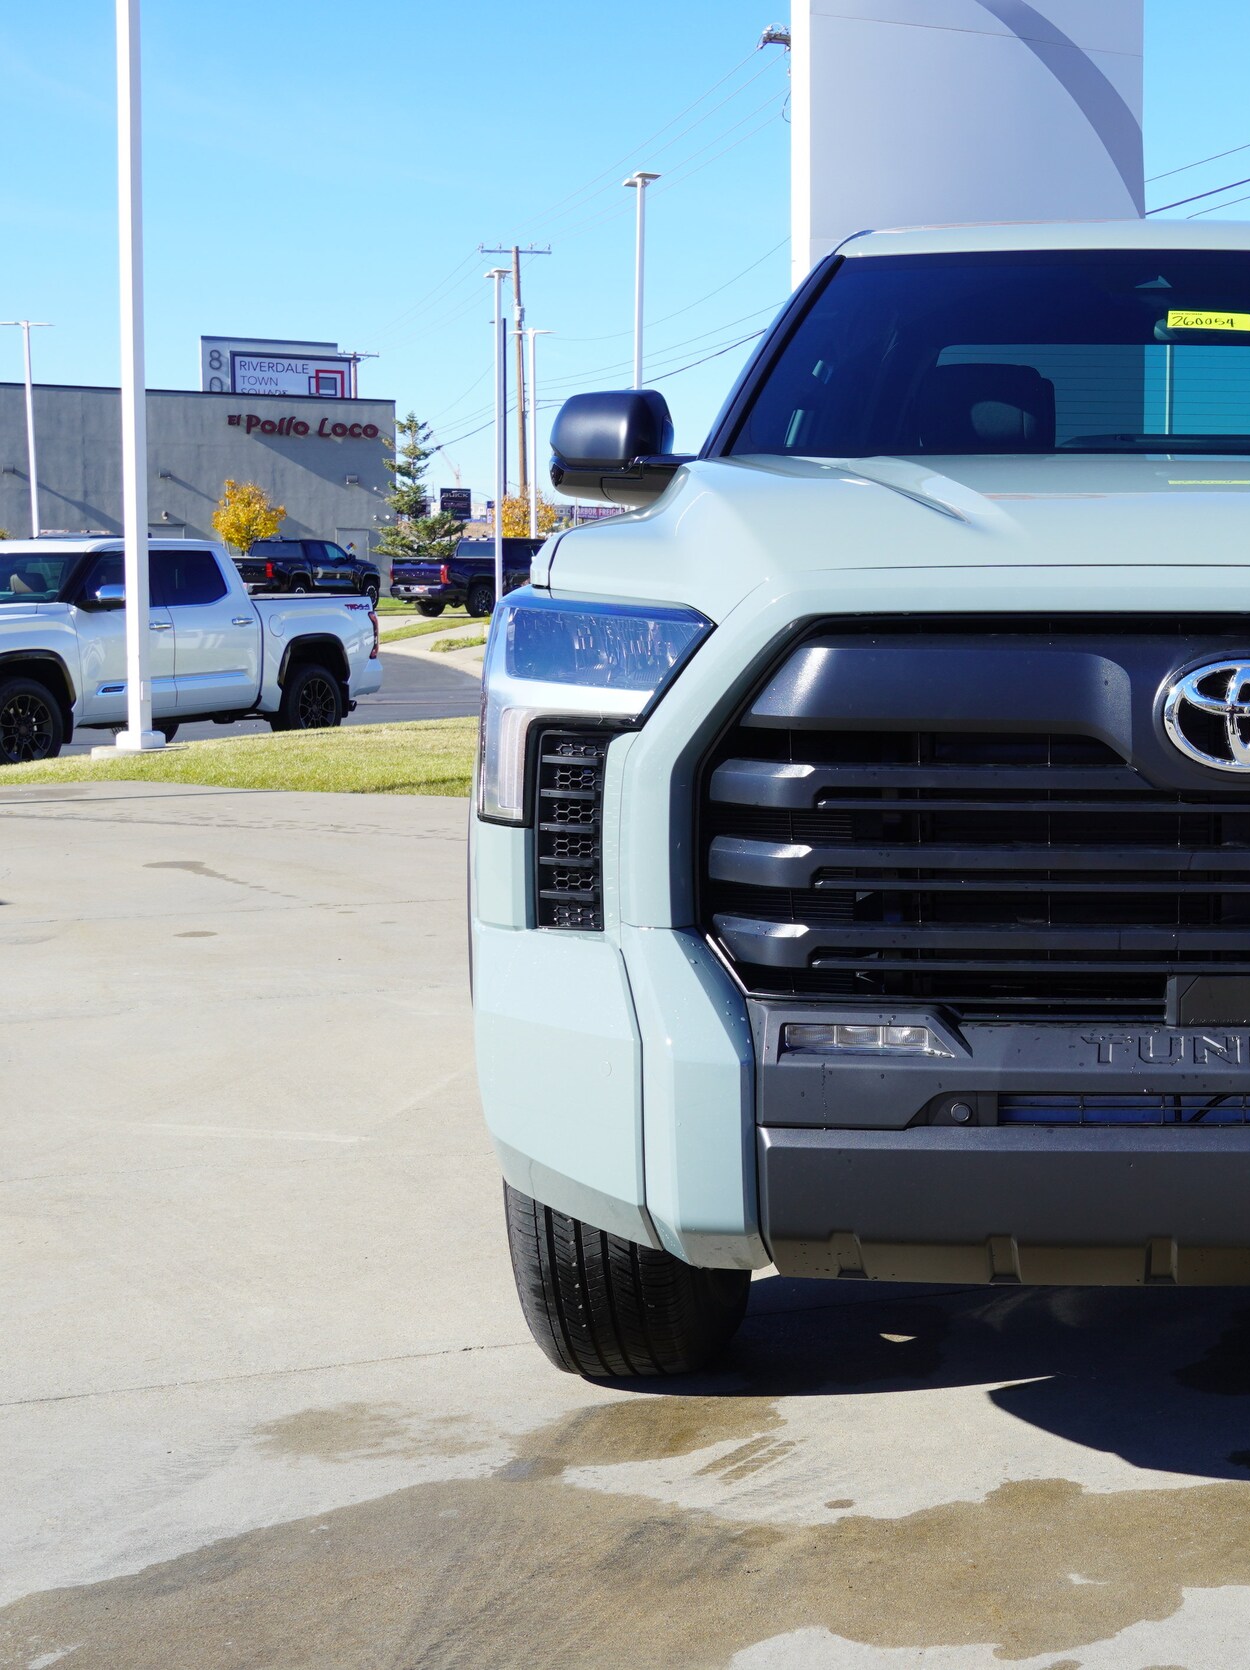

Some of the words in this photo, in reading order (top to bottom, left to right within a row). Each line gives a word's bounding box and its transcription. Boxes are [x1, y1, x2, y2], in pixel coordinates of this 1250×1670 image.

[239, 360, 310, 375] RIVERDALE
[240, 375, 279, 386] TOWN
[227, 414, 241, 426] El
[245, 413, 310, 437] Pollo
[318, 417, 379, 438] Loco
